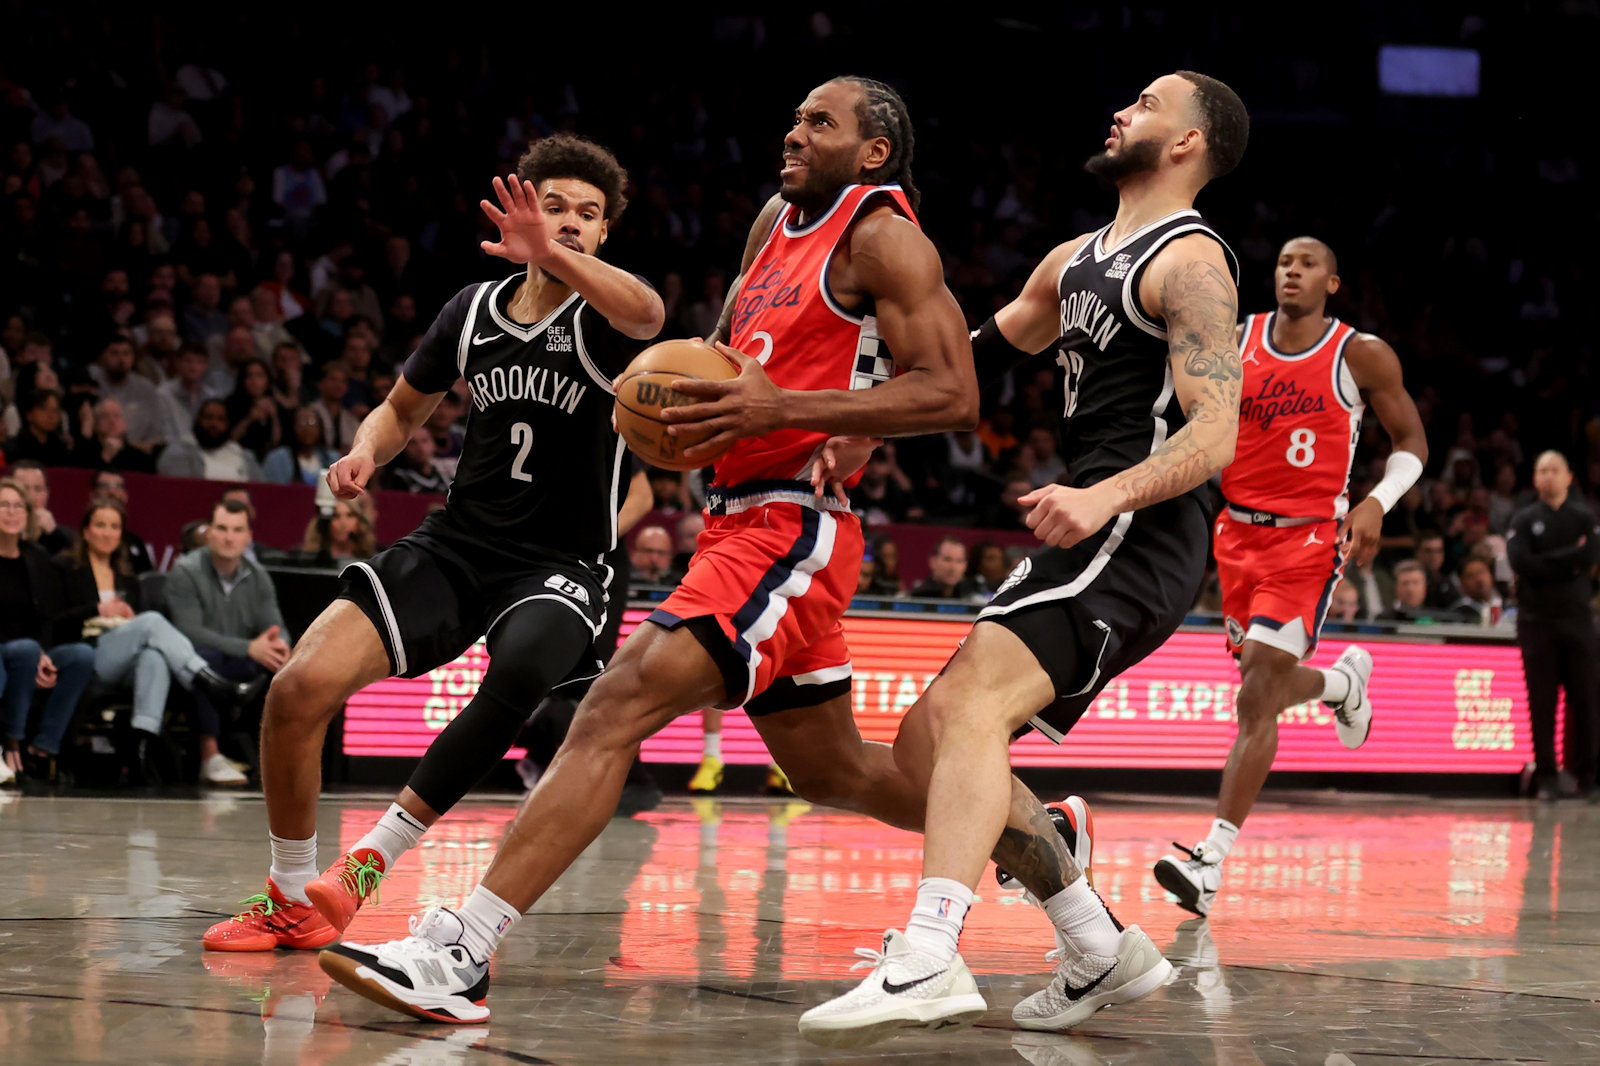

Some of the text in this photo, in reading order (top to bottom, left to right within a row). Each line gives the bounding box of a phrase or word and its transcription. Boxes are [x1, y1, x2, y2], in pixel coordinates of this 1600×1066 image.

[1111, 260, 1131, 272] YOUR
[1115, 253, 1131, 263] GET
[747, 257, 784, 291] Lo
[1105, 268, 1127, 280] GUIDE
[547, 326, 566, 335] GET
[1060, 289, 1122, 352] ROOKLYN
[546, 334, 572, 344] YOUR
[546, 343, 573, 352] GUIDE
[468, 365, 587, 415] BROOKLYN
[1256, 374, 1298, 400] Los
[1239, 389, 1326, 431] Angeles
[510, 422, 533, 483] 2
[1285, 427, 1317, 468] 8
[428, 668, 483, 695] YO
[1453, 668, 1495, 698] GET
[1454, 697, 1513, 722] YOUR
